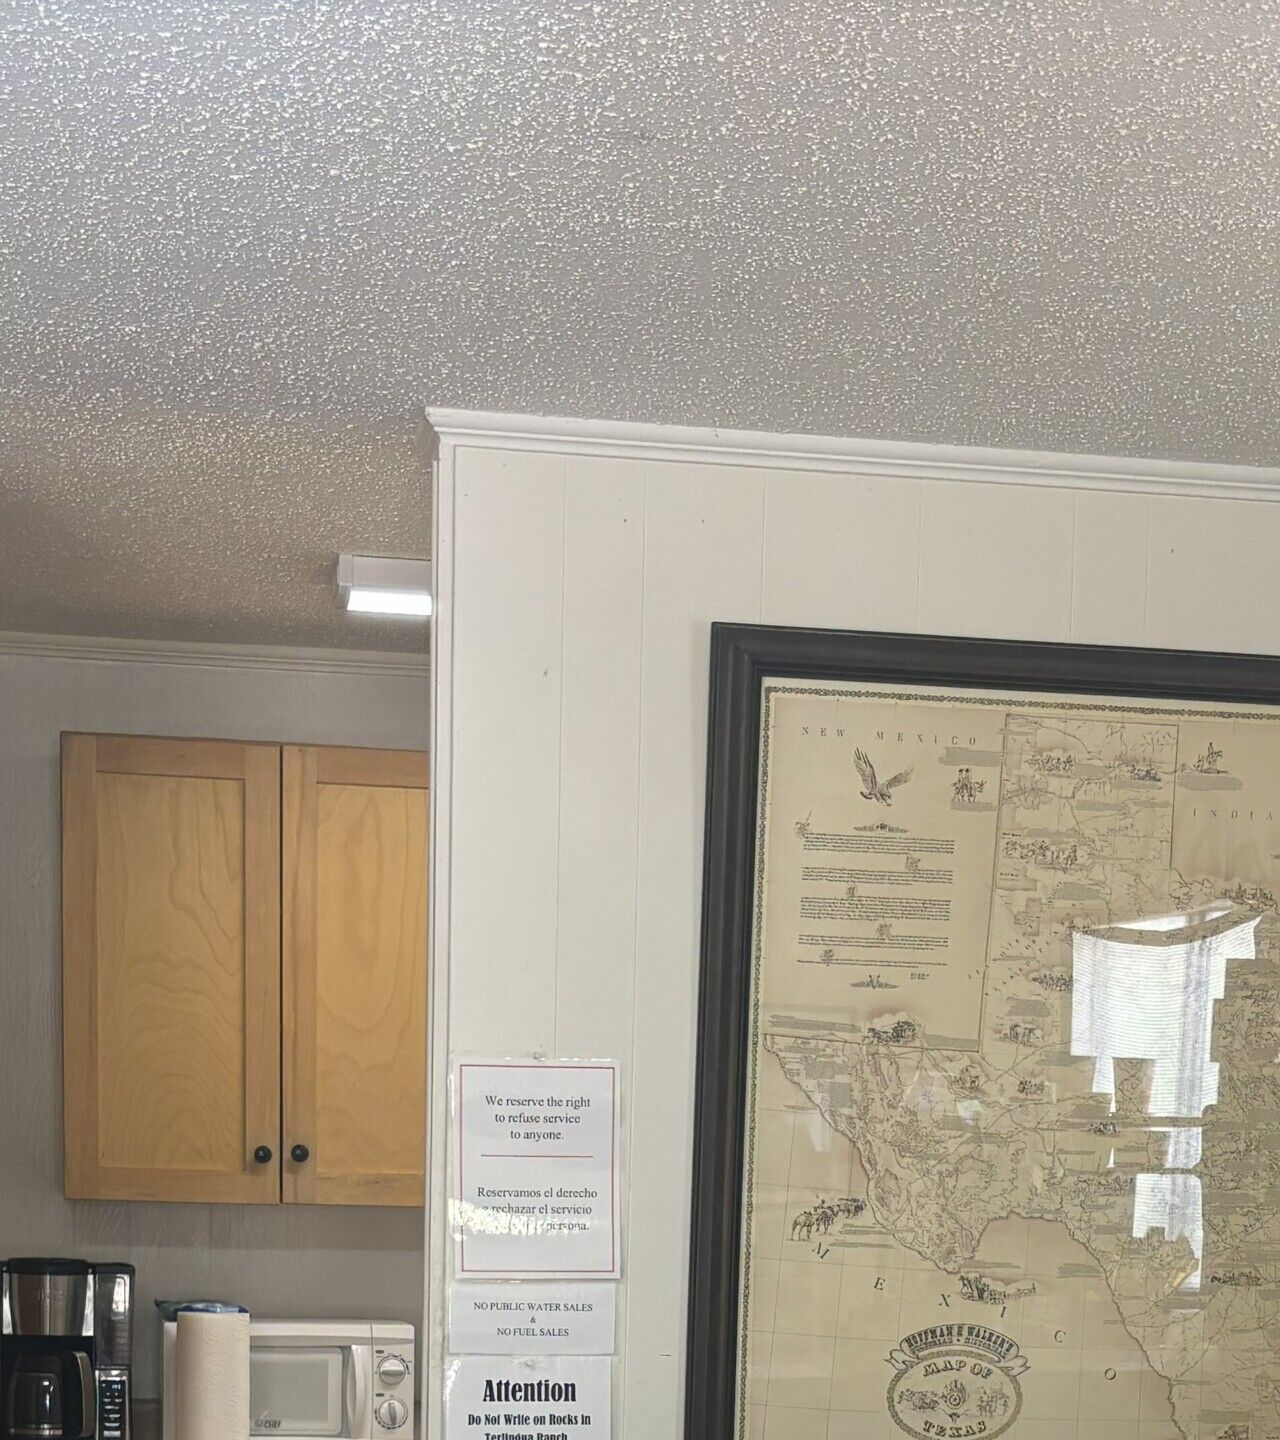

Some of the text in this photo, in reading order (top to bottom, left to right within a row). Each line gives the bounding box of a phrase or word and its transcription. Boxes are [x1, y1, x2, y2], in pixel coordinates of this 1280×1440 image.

[485, 1095, 590, 1110] We reserve the right
[495, 1113, 580, 1124] to refuse service
[511, 1131, 564, 1142] to anyone.
[478, 1187, 597, 1198] Reservamos el derecho
[474, 1302, 593, 1311] NO PUBLIC WATER SALES
[497, 1328, 511, 1336] NO
[514, 1328, 537, 1336] FUEL
[923, 1360, 993, 1378] MAP OF
[483, 1379, 577, 1402] Attention
[468, 1413, 591, 1425] Do Not Write on Rocks in
[923, 1420, 986, 1438] TEXAS
